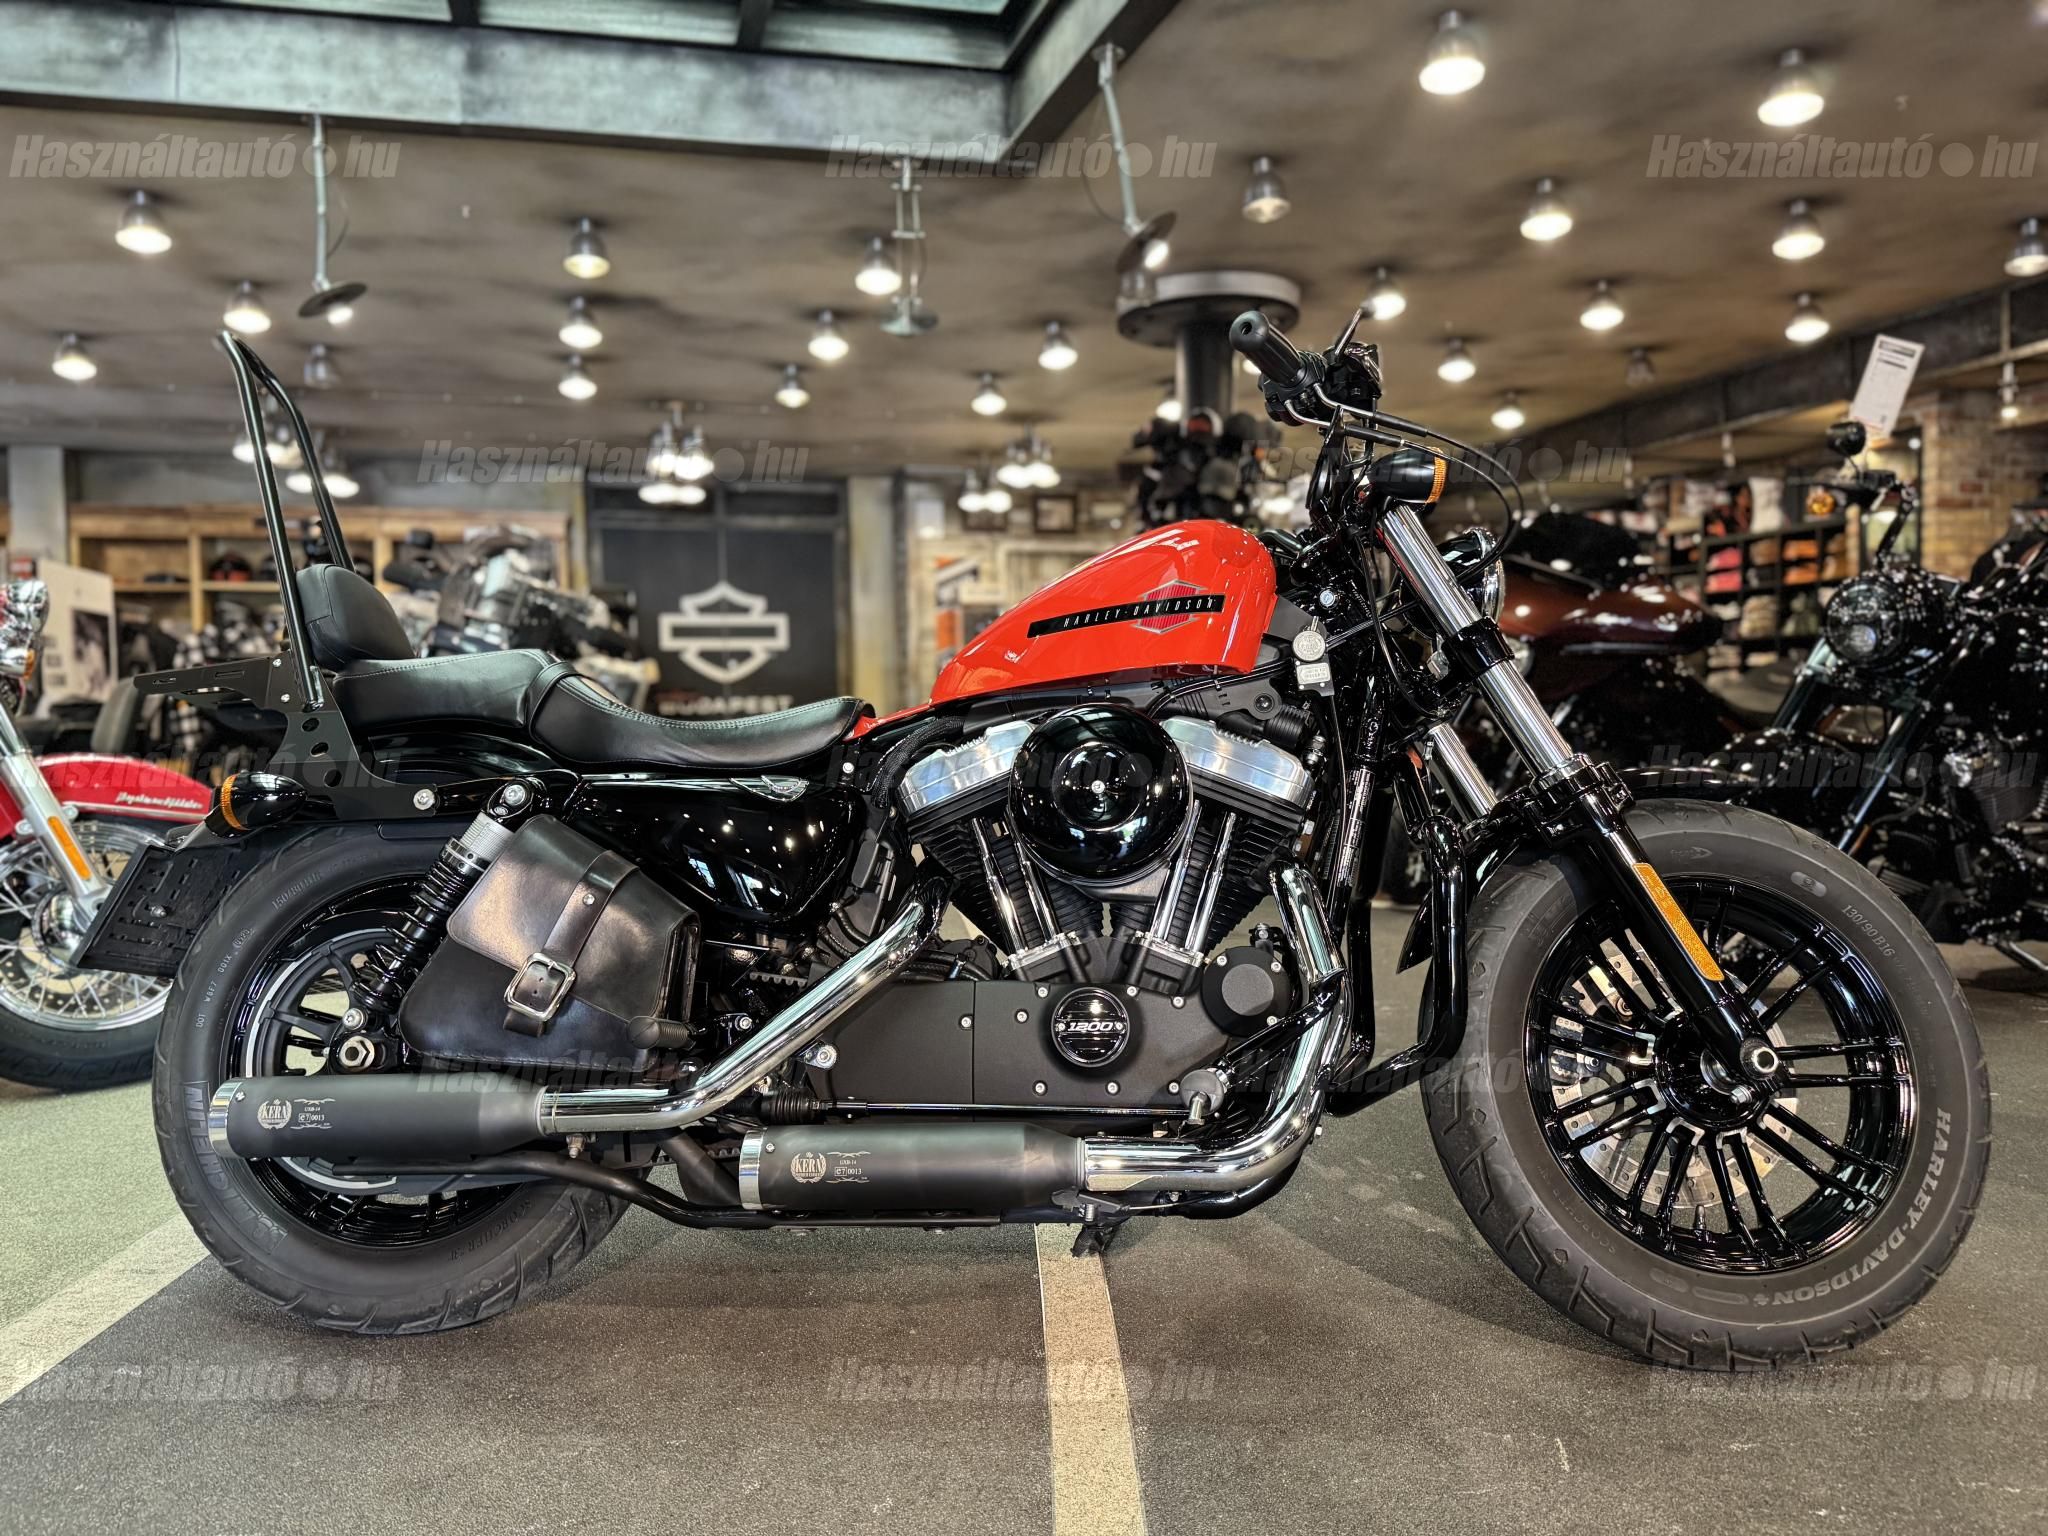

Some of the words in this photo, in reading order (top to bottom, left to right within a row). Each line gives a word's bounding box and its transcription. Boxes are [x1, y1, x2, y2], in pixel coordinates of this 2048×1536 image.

[1063, 598, 1214, 628] HARLEY-DAVIDSON
[195, 1012, 208, 1029] DOT
[1067, 1021, 1114, 1032] 1200
[1771, 1107, 1952, 1306] HARLEY-DAVIDSON
